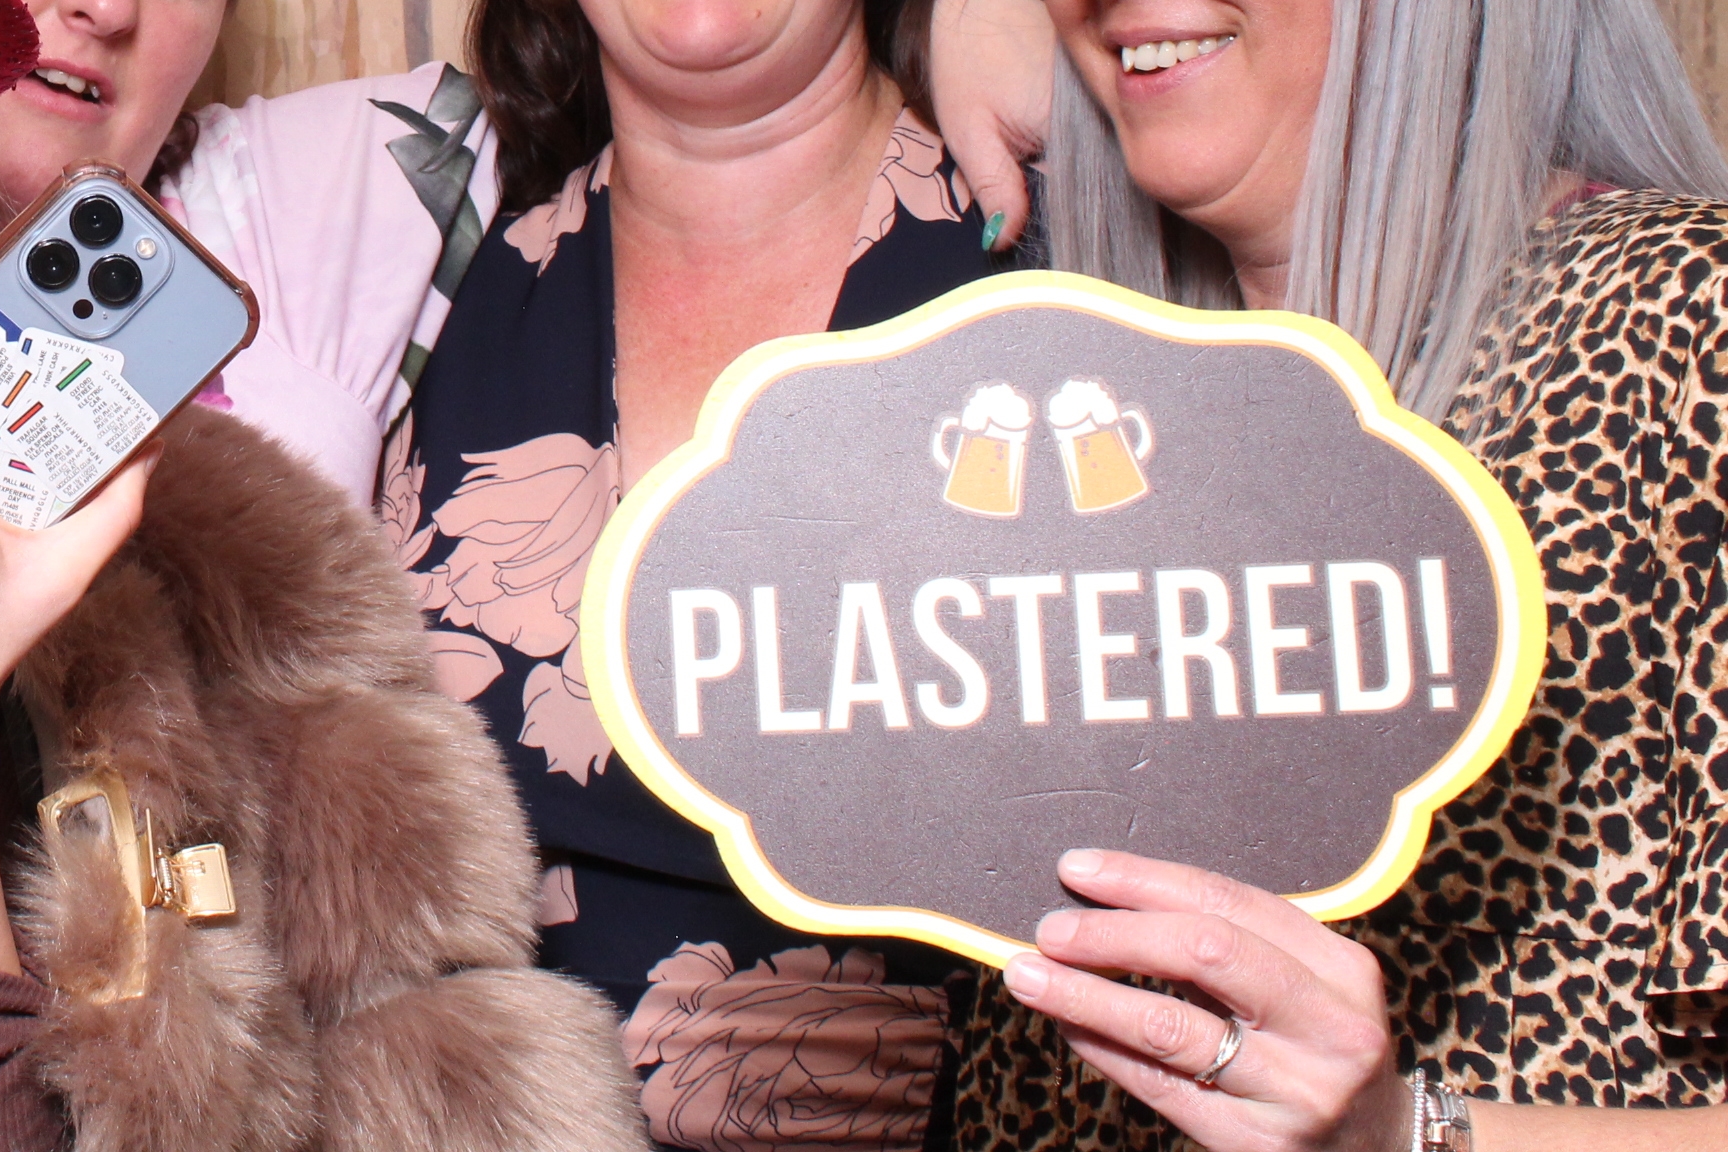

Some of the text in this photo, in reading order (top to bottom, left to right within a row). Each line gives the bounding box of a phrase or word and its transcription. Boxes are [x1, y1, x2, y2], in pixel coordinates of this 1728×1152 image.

[48, 351, 59, 369] CASH
[3, 370, 15, 385] VINE
[69, 376, 92, 397] OXFORD
[74, 381, 96, 401] STREET
[77, 385, 104, 409] ELECTRIC
[88, 395, 101, 408] CAR
[16, 415, 48, 443] TRAFALGAR
[24, 423, 48, 444] SQUARE
[33, 430, 53, 448] SPEND
[50, 423, 60, 433] ON
[96, 420, 117, 439] COLLECT
[115, 425, 147, 454] RULES APPLY
[28, 428, 64, 460] ELECTRICALS
[48, 462, 70, 481] COLLECT
[2, 476, 36, 491] PALL MALL
[67, 468, 99, 497] RULES APPLY
[7, 494, 20, 502] DAY
[671, 559, 1456, 735] PLASTERED!
